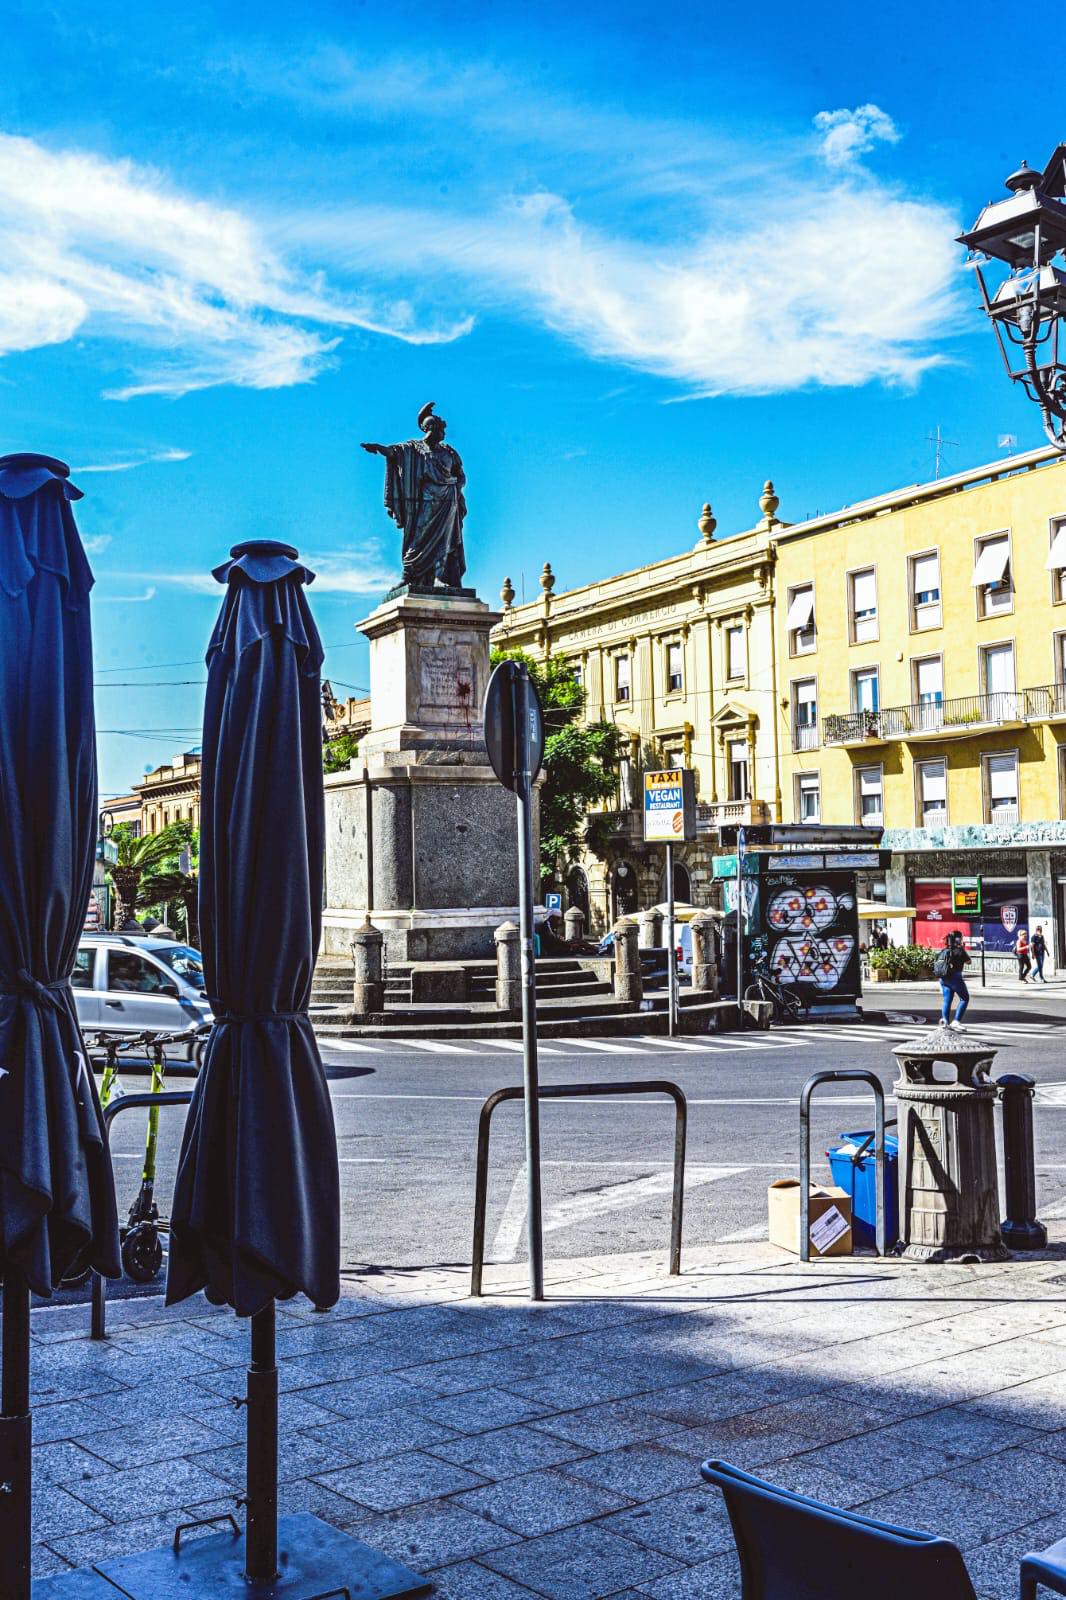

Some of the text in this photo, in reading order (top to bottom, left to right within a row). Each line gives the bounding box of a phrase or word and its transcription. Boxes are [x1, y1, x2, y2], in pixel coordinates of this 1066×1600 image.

[569, 606, 676, 641] CAMERA DI COMMERCIO
[650, 772, 678, 783] TAXI
[649, 789, 680, 802] VEGAN
[650, 801, 680, 809] RESTAURANT
[549, 895, 559, 908] P
